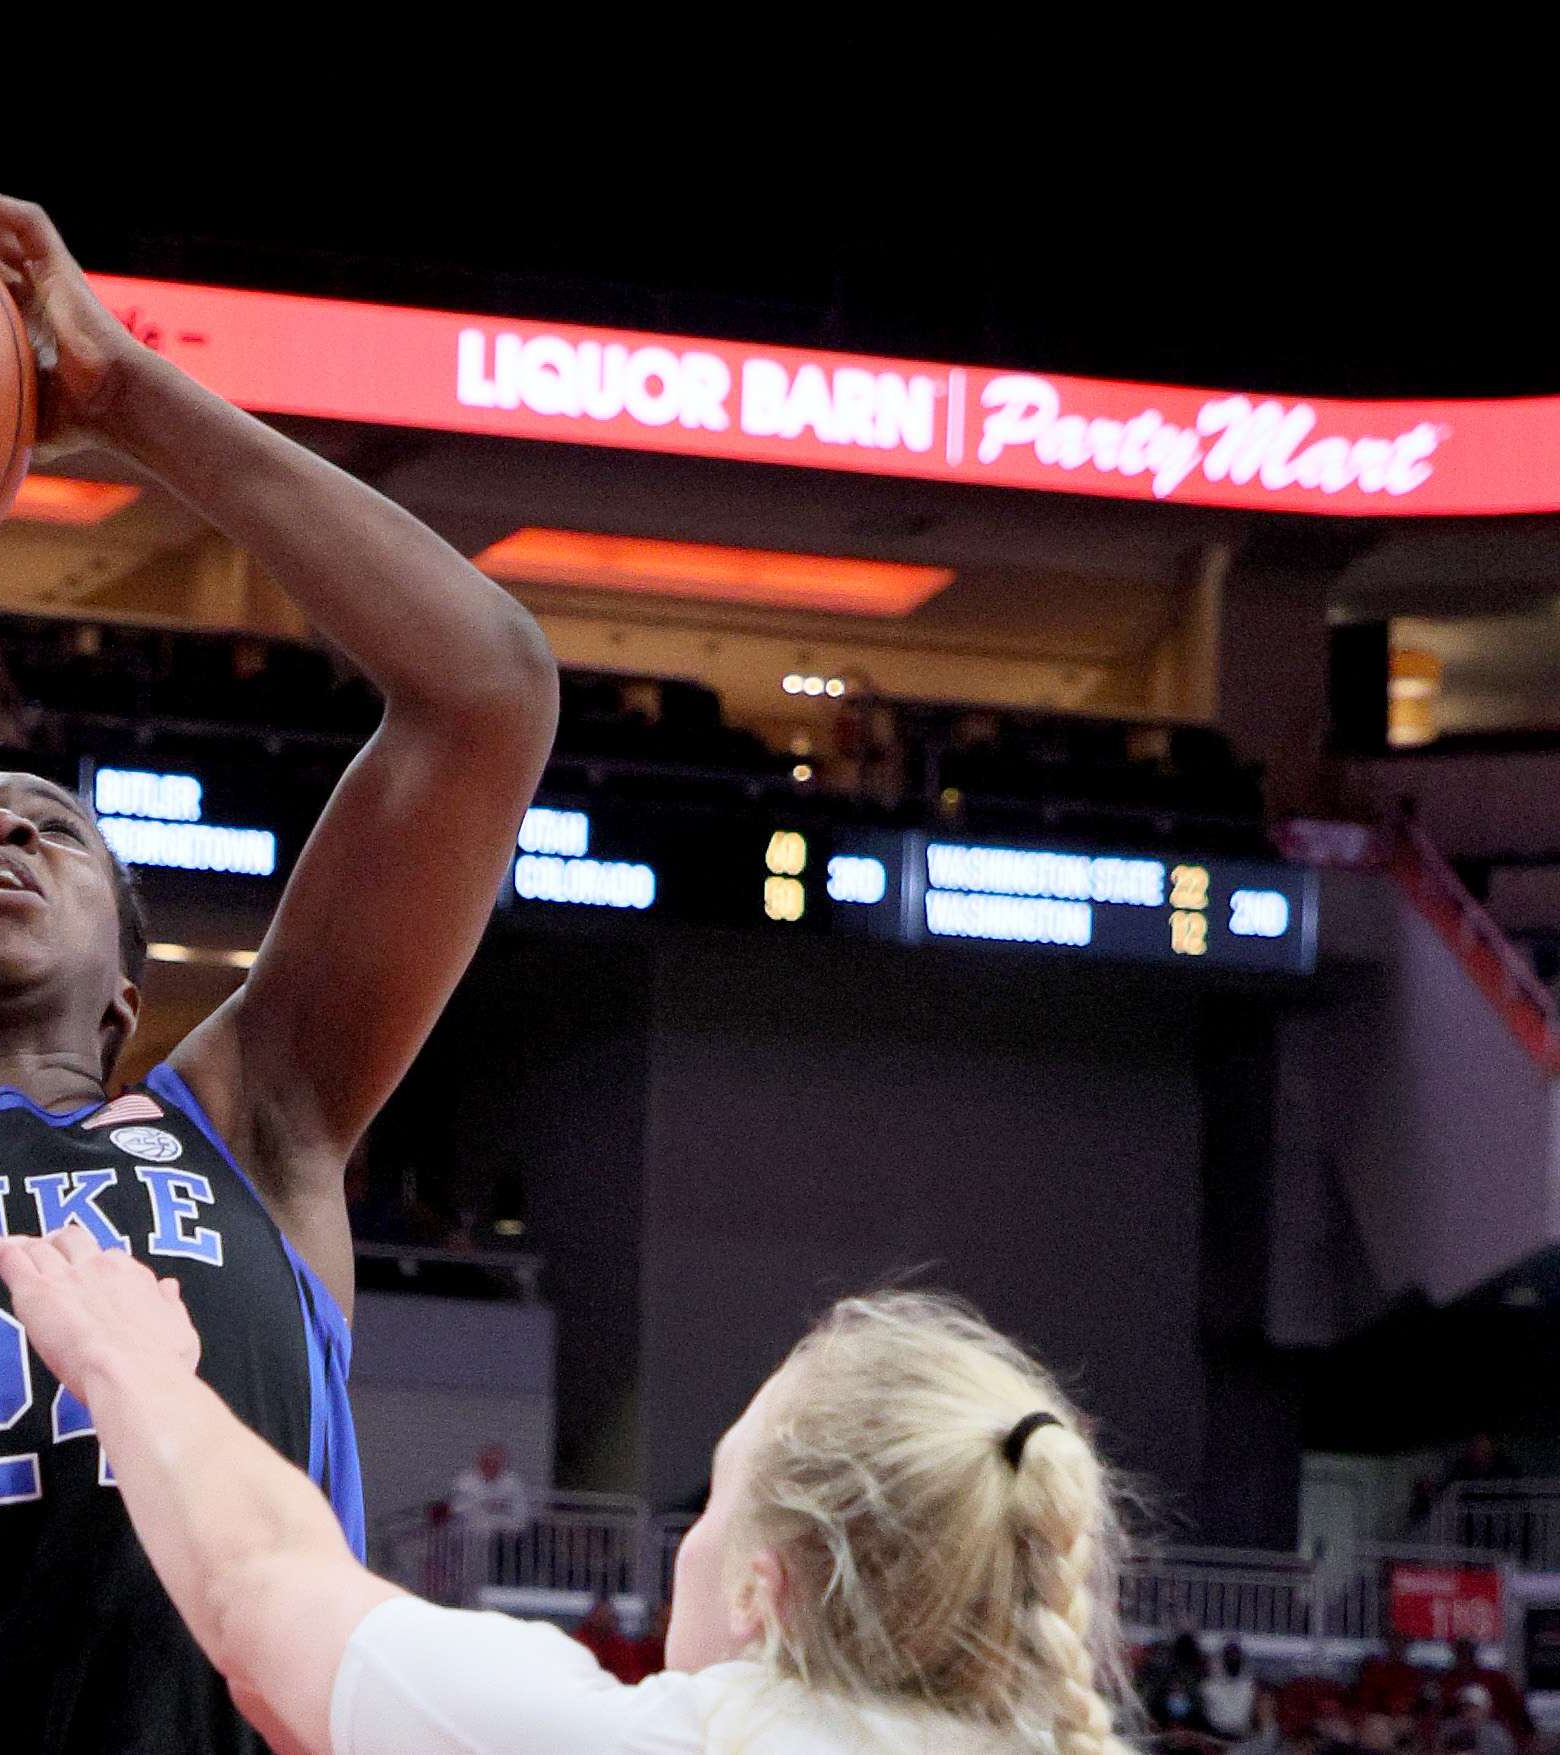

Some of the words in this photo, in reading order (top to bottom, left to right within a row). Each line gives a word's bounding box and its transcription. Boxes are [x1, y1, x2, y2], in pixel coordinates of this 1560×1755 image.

[456, 327, 731, 432] LIQUOR
[740, 357, 935, 453] BARN
[978, 373, 1442, 499] PartyMart
[926, 843, 1092, 899] WASHINGTON
[1092, 857, 1165, 906] STATE
